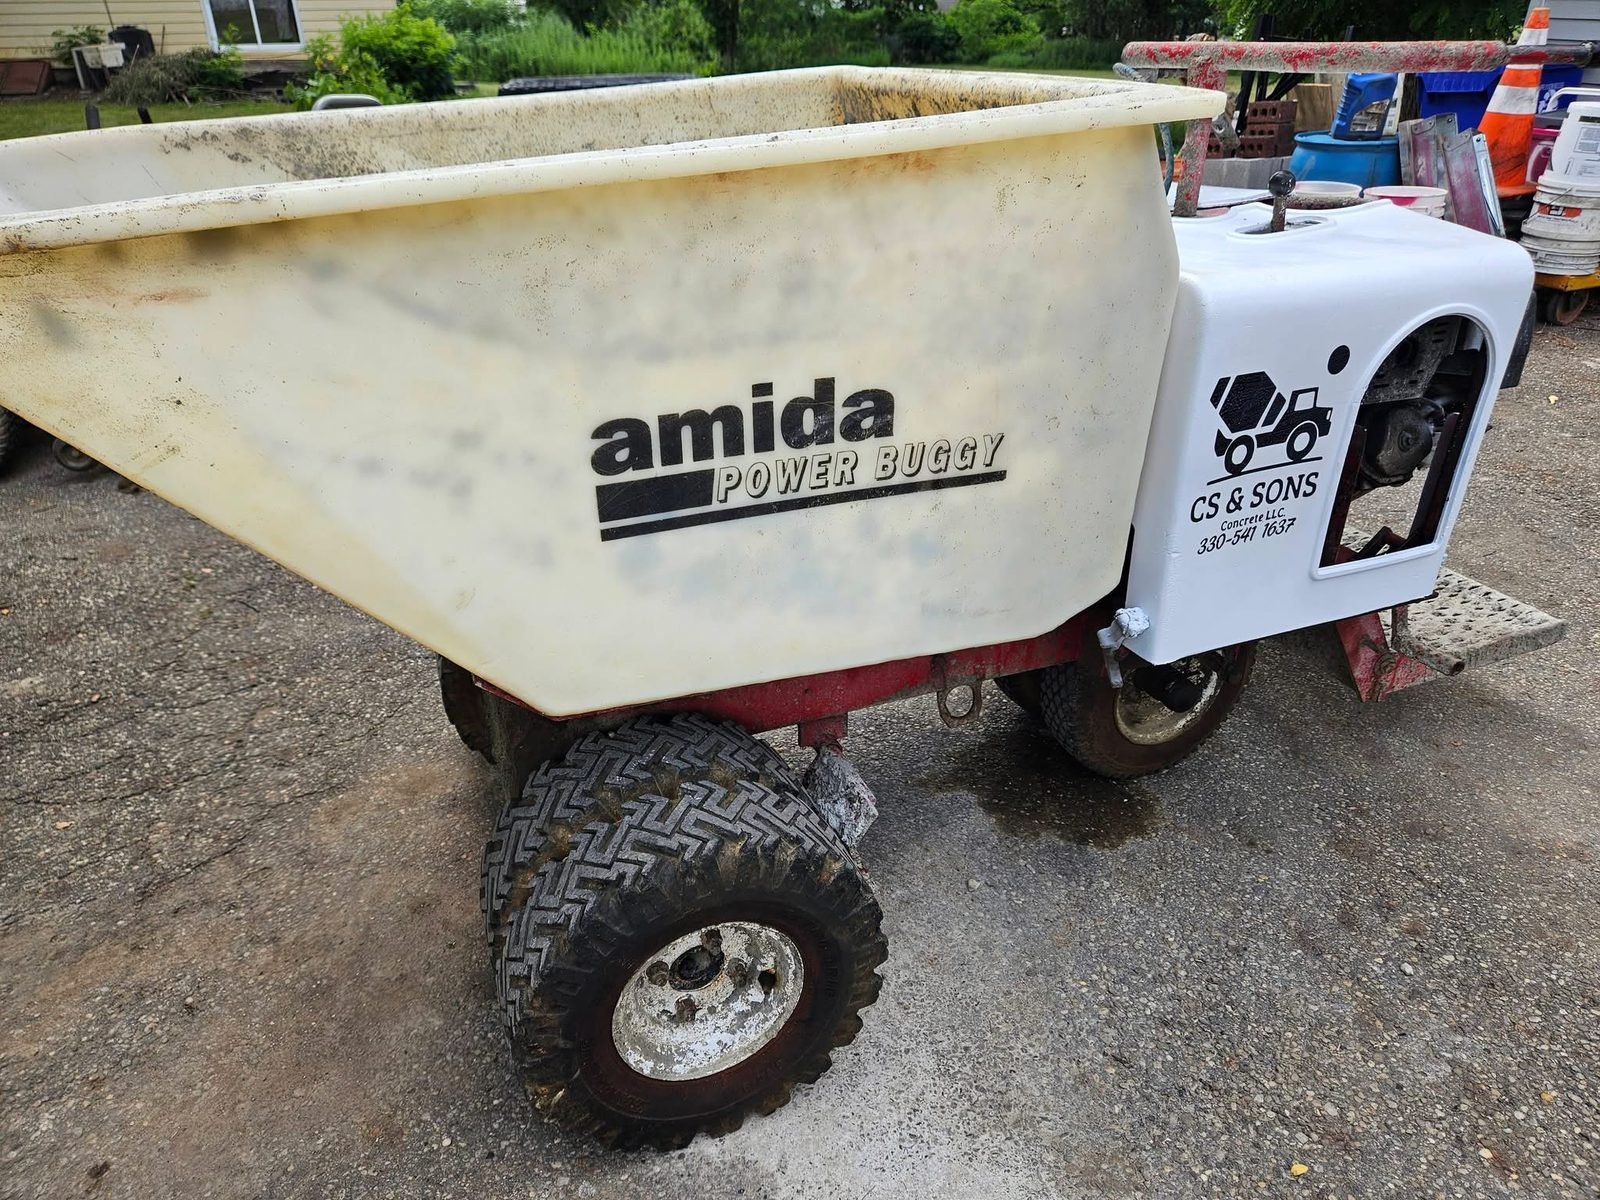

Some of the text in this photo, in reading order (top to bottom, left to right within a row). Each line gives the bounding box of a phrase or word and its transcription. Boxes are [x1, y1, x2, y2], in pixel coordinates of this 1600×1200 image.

[590, 377, 895, 476] amida
[716, 433, 1004, 502] POWER BUGGY
[1190, 472, 1319, 523] CS & SONS
[1220, 507, 1286, 531] Concrete LLC.
[1197, 517, 1297, 555] 330-541 1637
